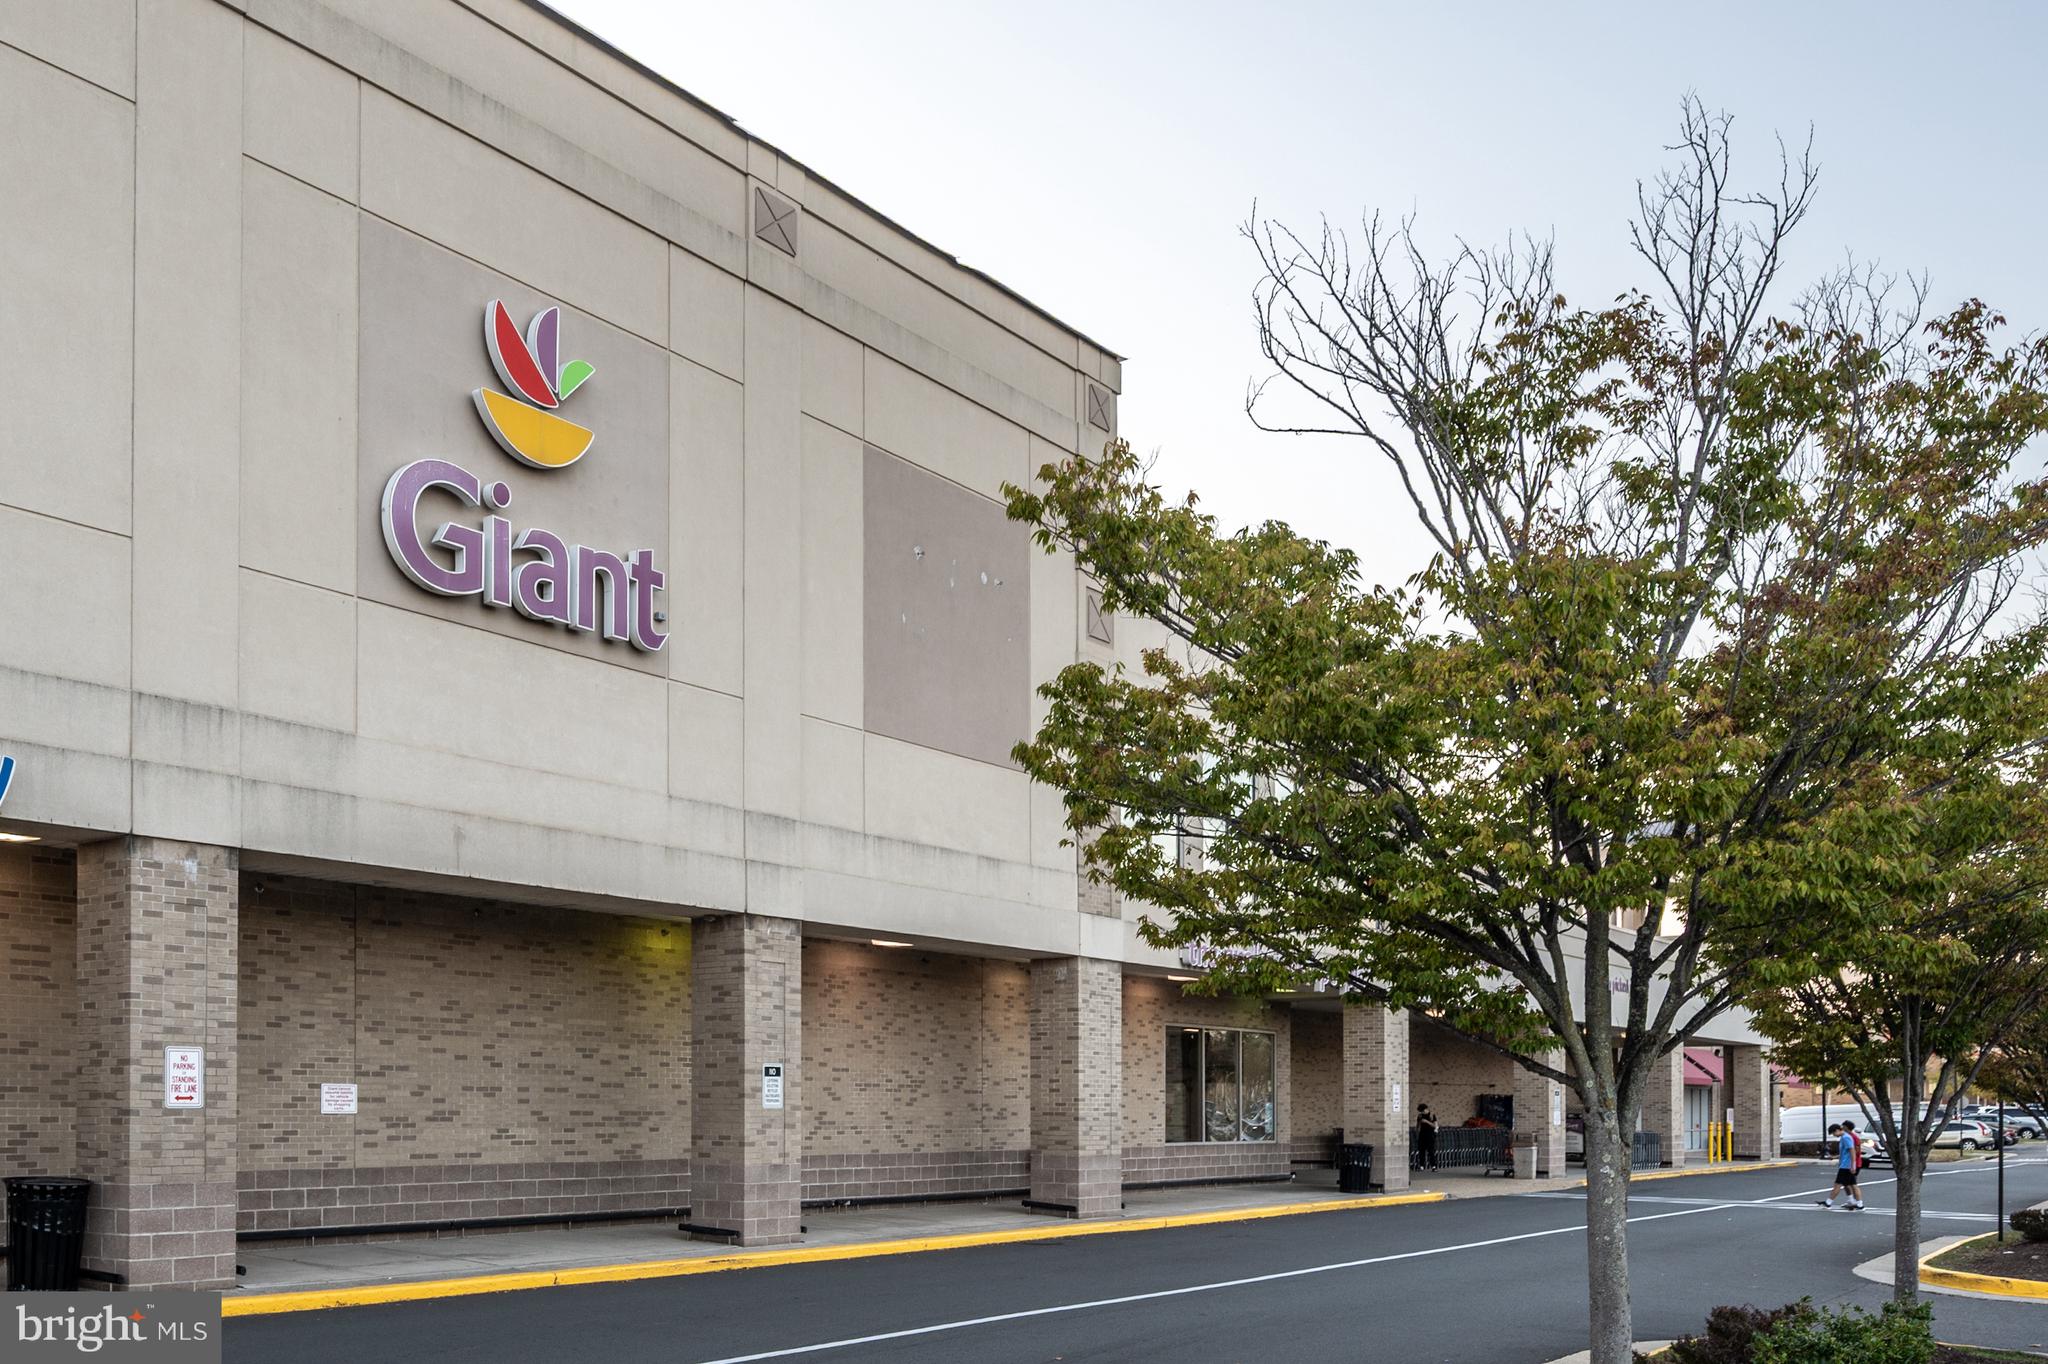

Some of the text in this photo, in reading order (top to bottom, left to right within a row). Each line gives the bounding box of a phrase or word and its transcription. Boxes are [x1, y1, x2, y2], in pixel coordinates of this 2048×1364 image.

[381, 458, 670, 651] Giant
[171, 1084, 197, 1093] FIRE LANE
